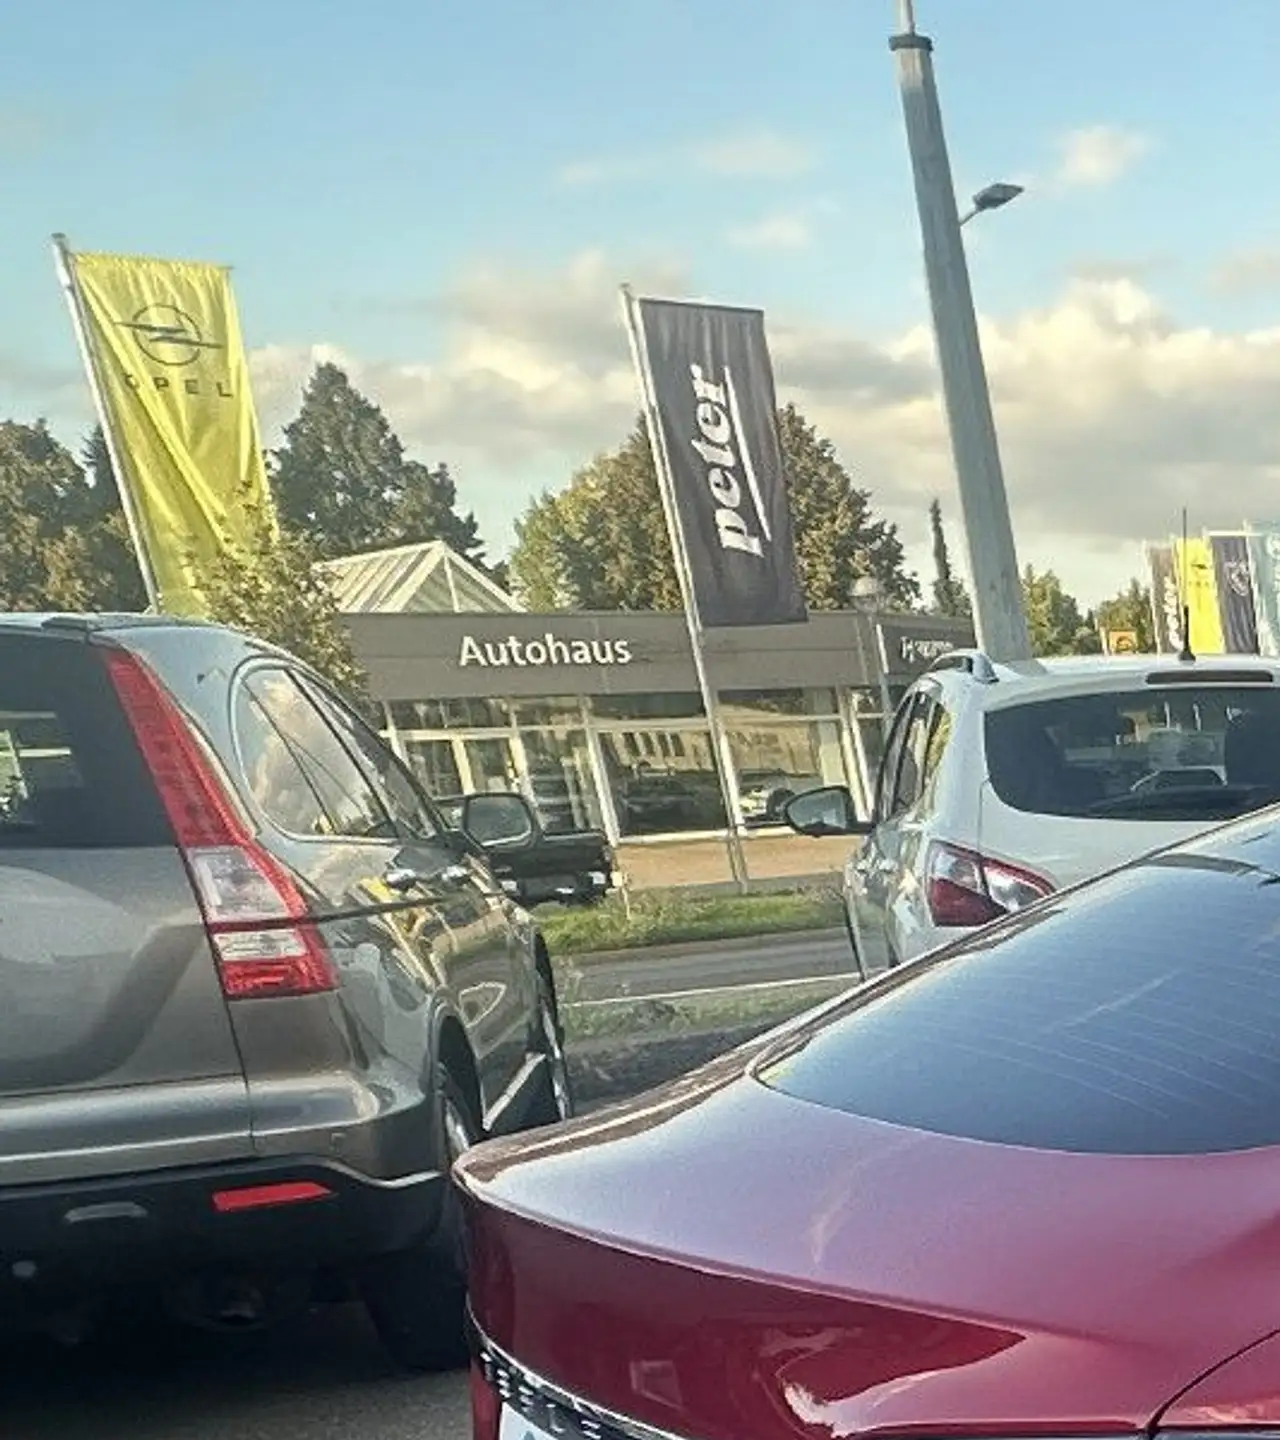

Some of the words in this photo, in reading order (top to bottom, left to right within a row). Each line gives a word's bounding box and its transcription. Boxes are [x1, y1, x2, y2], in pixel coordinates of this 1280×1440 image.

[123, 372, 234, 398] OPEL
[690, 364, 764, 558] peter
[459, 633, 632, 667] Autohaus
